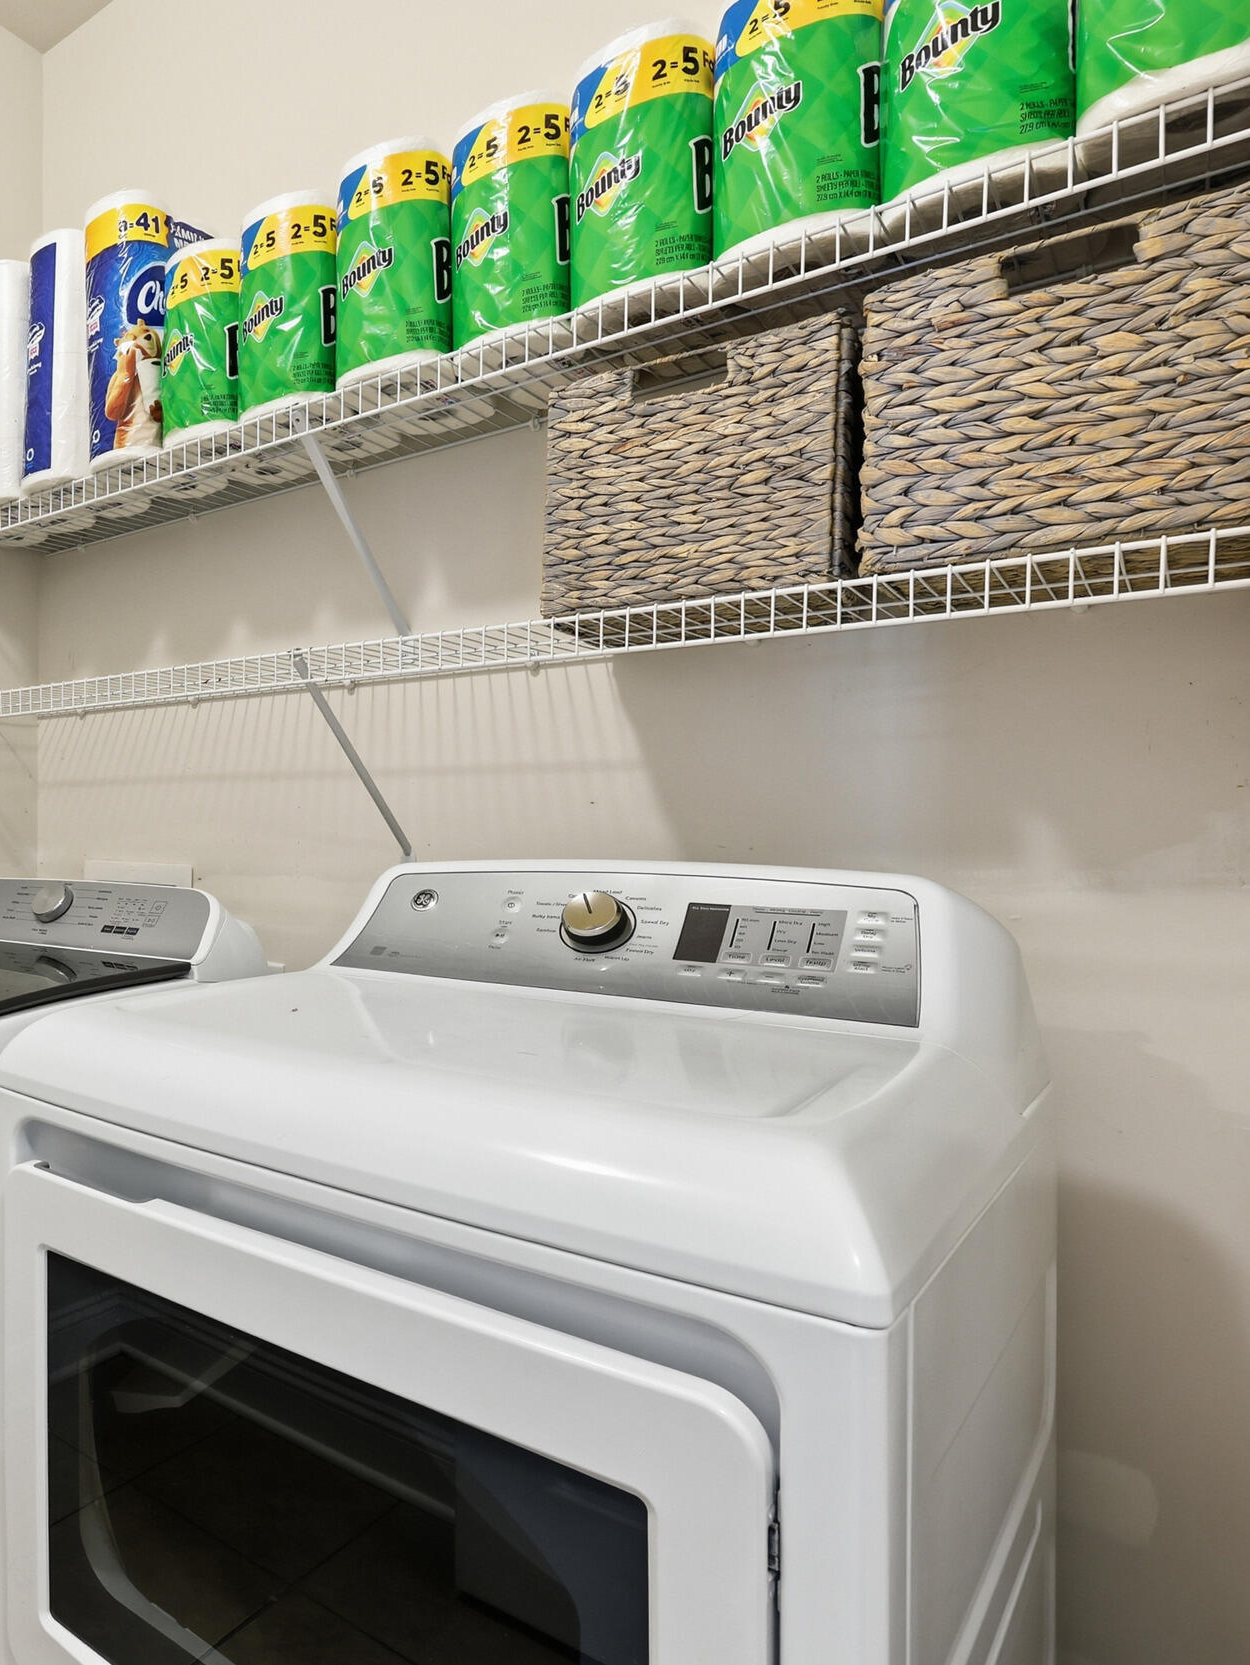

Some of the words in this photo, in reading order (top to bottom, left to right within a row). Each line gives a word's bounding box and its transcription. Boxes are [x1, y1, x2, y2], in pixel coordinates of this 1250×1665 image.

[900, 0, 1000, 91] Bounty
[722, 81, 802, 161] Bounty
[577, 154, 641, 223] Bounty
[341, 246, 393, 301] Bounty
[455, 210, 509, 272] Bounty
[242, 295, 285, 345] Bounty
